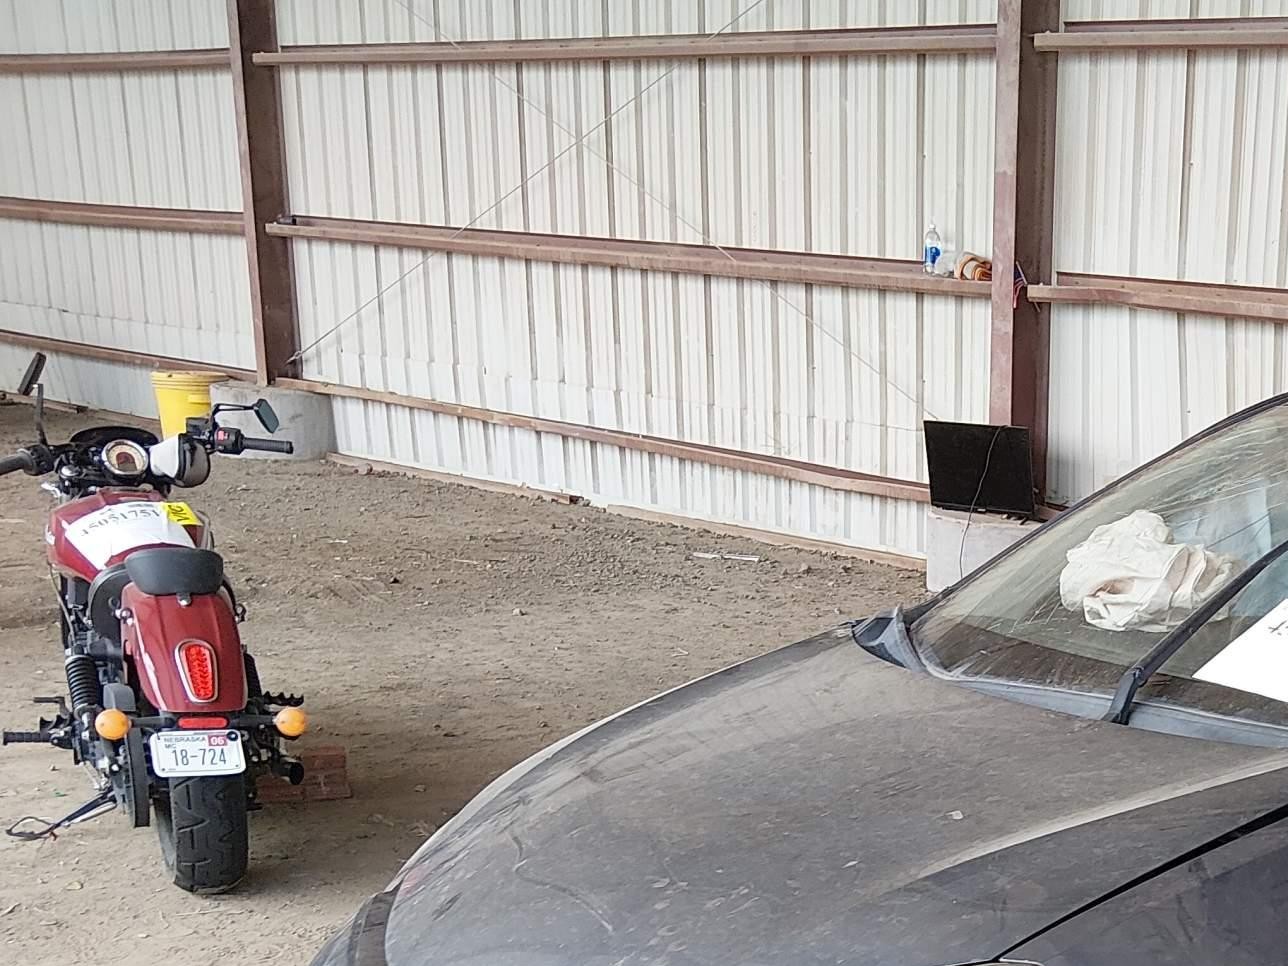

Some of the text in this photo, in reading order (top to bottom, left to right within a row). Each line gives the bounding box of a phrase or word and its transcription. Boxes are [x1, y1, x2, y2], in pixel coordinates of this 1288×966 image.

[163, 734, 207, 743] NEBRASKA
[210, 736, 225, 746] 06
[172, 748, 226, 767] 18-724
